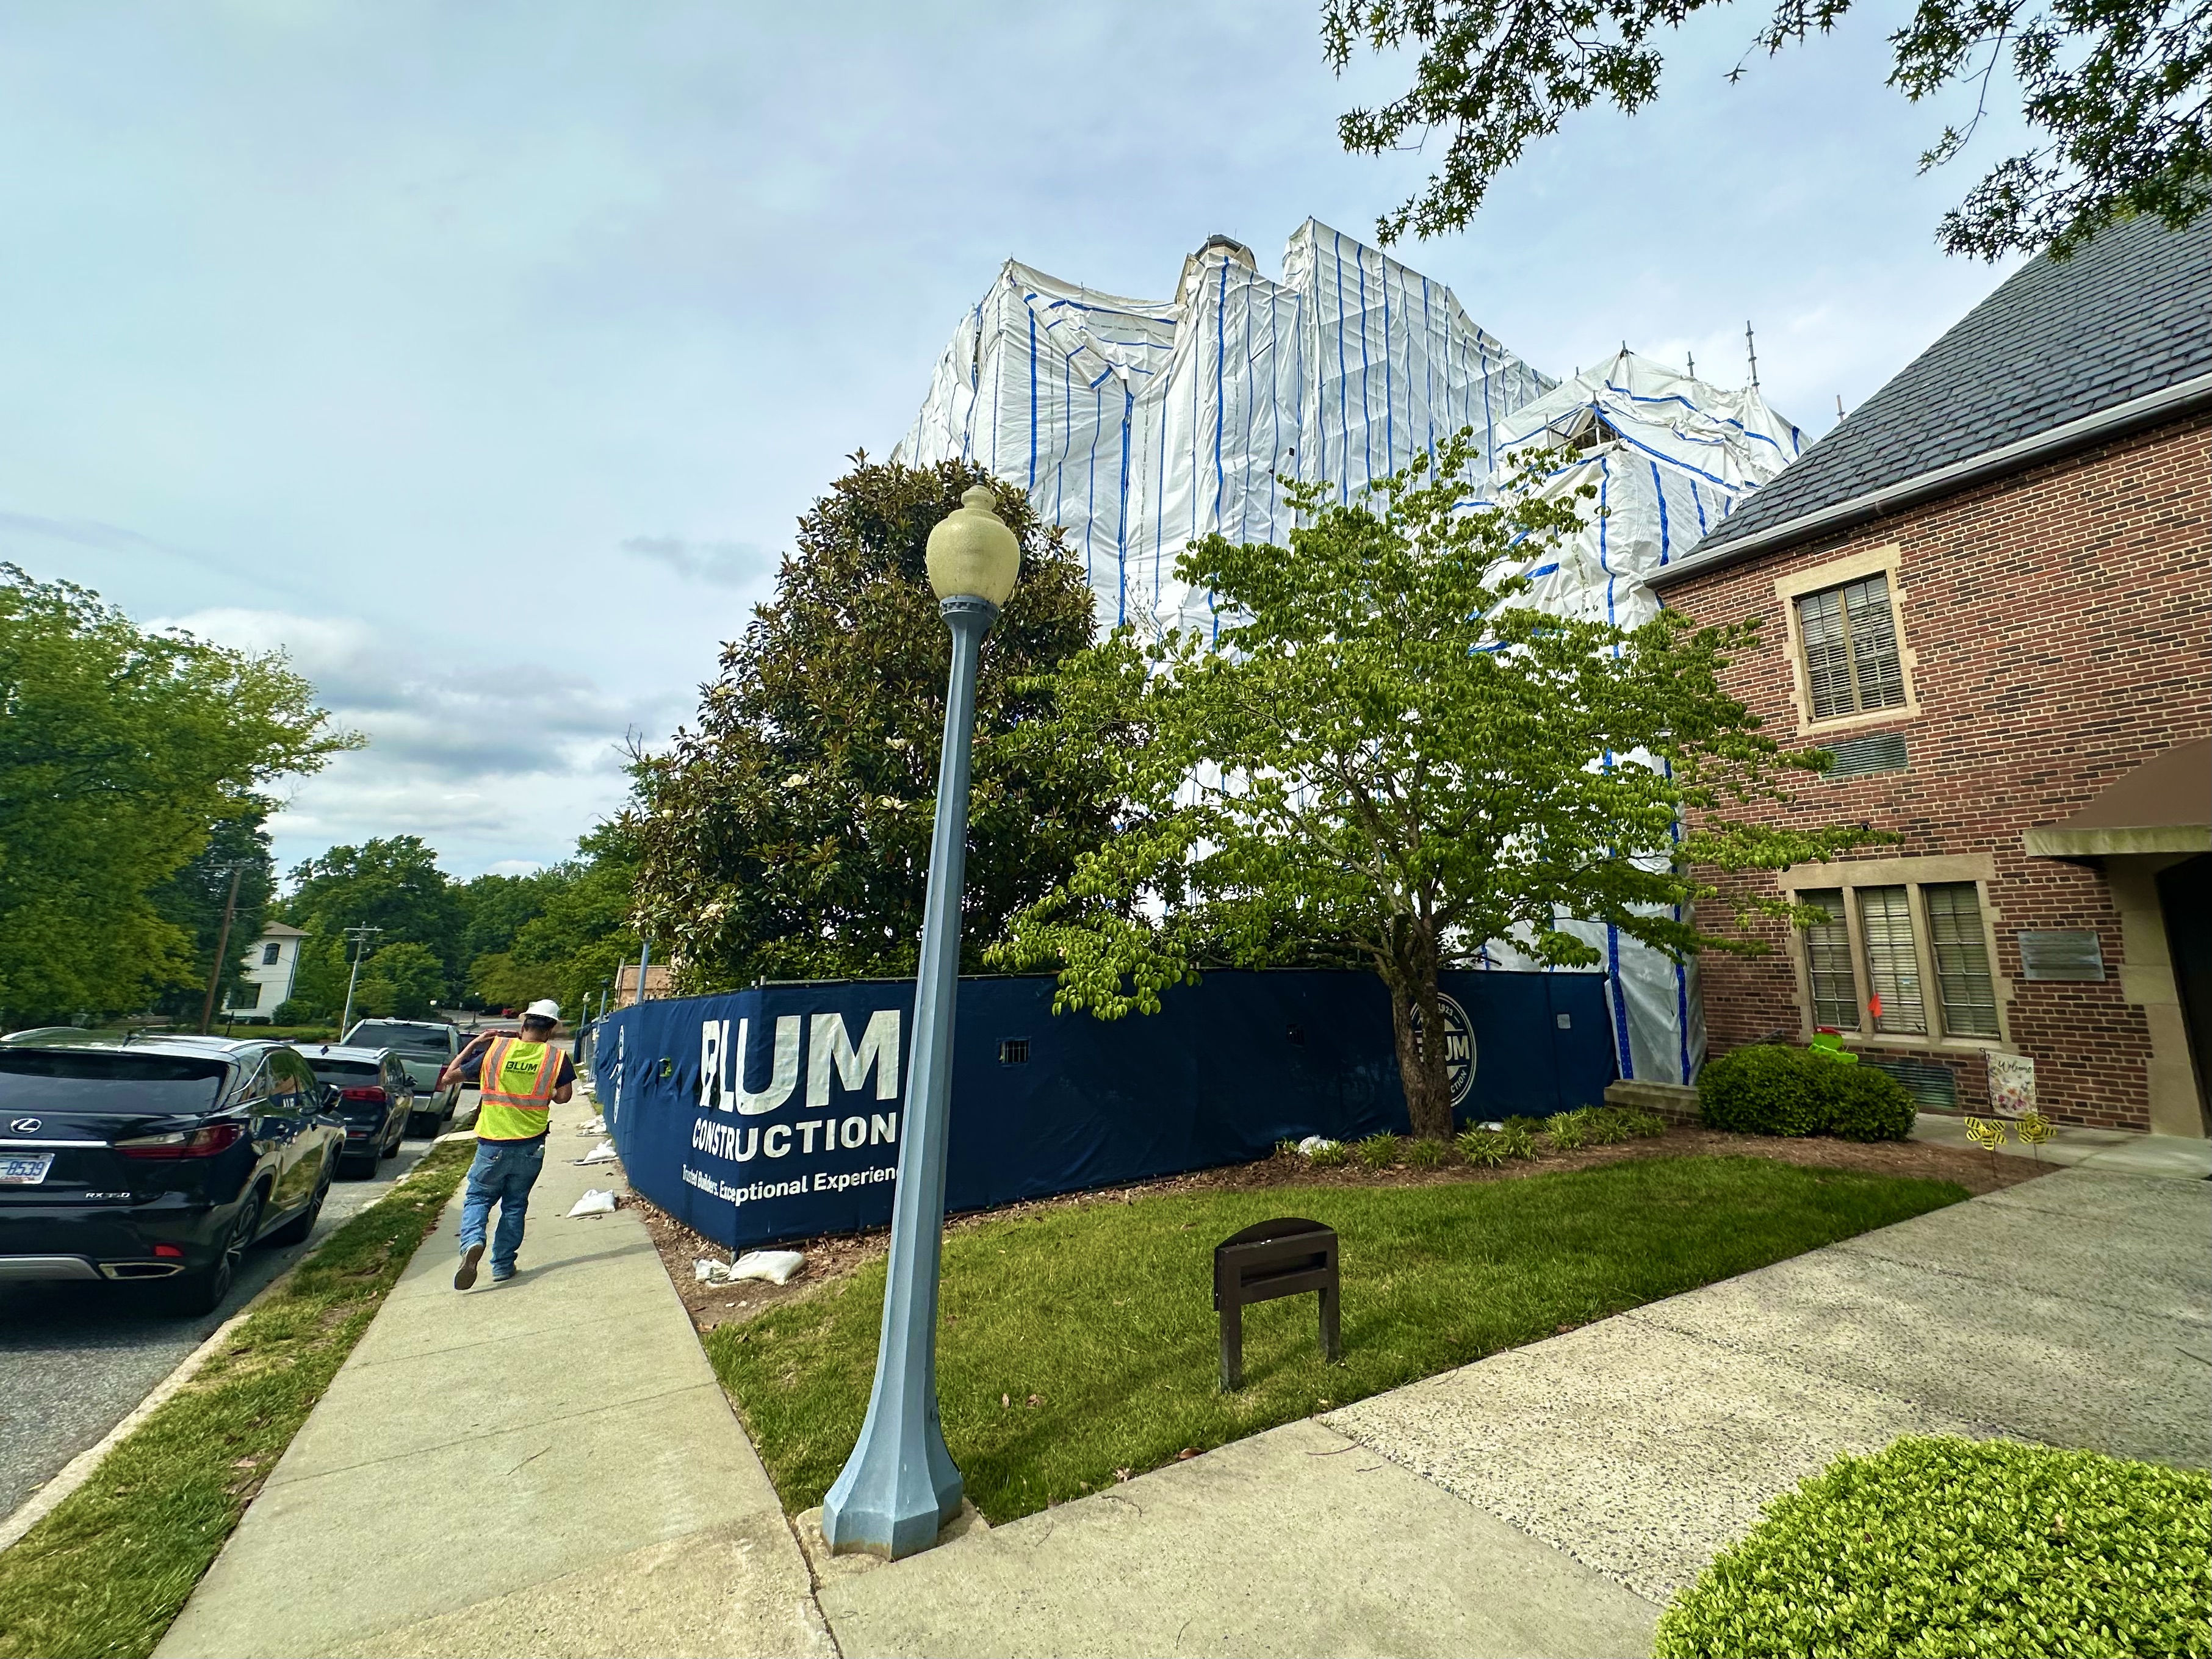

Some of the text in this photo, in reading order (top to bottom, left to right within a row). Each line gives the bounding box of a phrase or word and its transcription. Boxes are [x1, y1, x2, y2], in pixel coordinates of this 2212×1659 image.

[505, 1061, 538, 1071] BLUM
[692, 1112, 896, 1162] CONSTRUCTION
[719, 1175, 809, 1207] Exceptional
[813, 1166, 898, 1192] Experien
